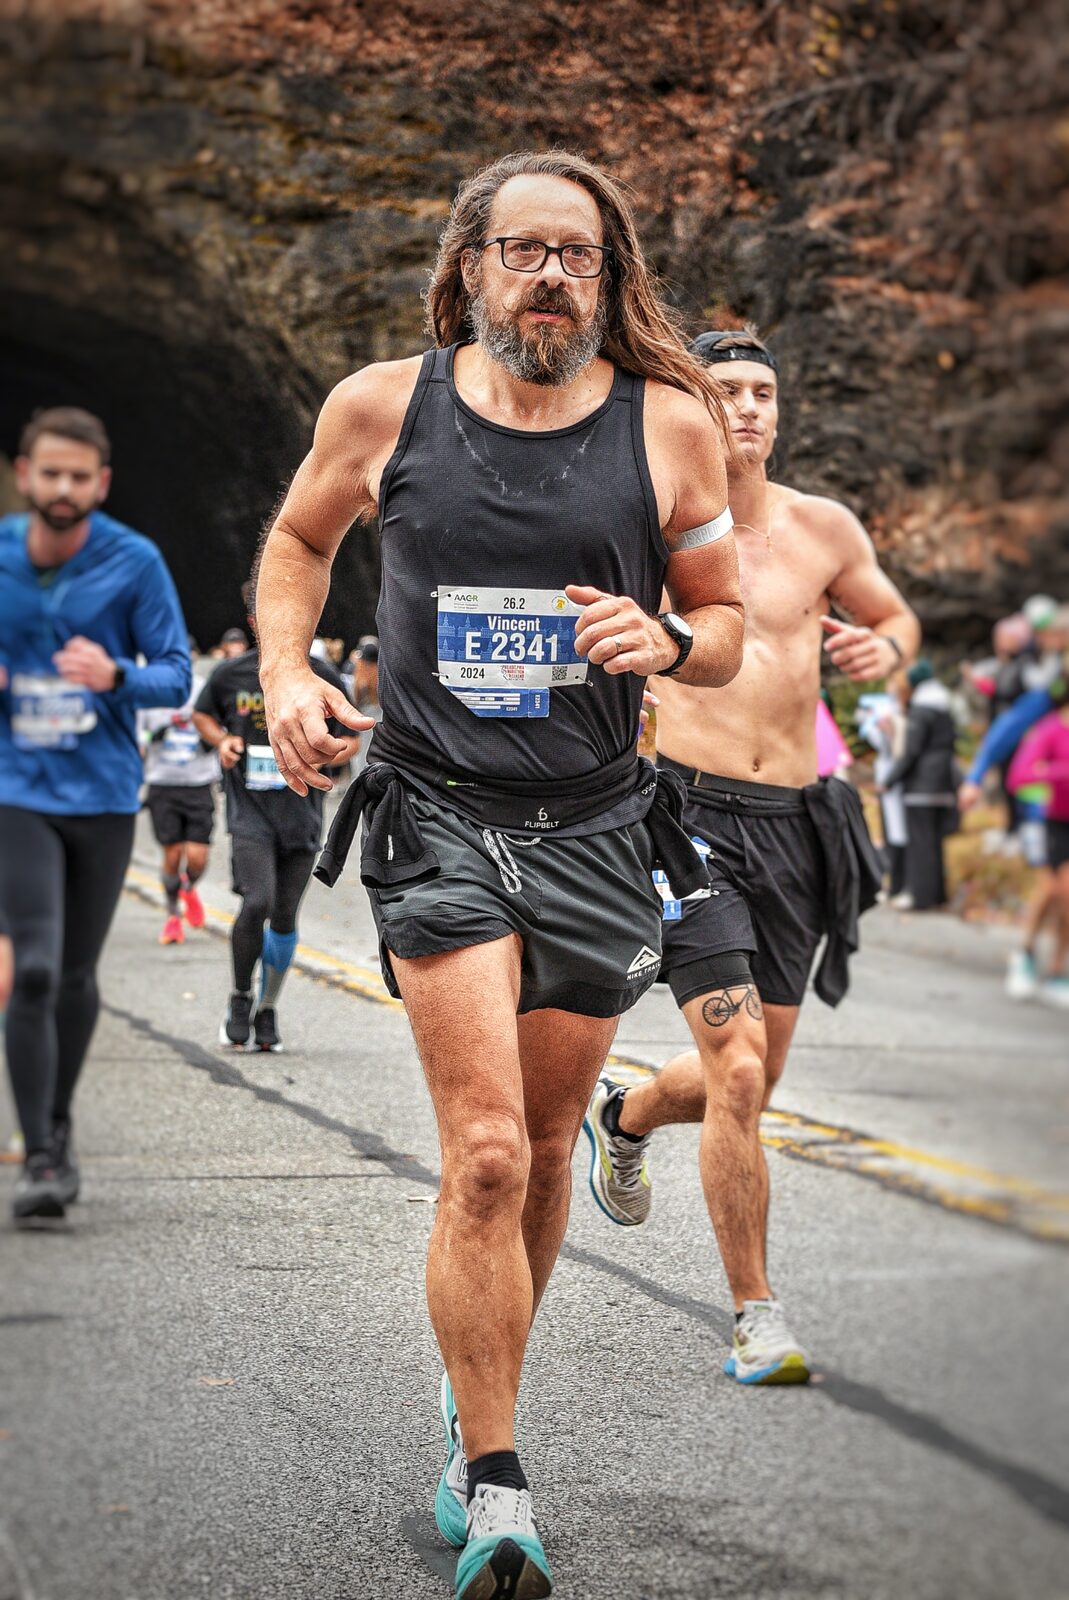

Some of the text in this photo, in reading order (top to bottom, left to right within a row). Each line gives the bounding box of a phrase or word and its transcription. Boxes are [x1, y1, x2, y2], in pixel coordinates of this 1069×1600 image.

[503, 597, 525, 610] 26.2
[487, 615, 541, 632] Vincent
[465, 631, 558, 662] E 2341
[460, 667, 485, 679] 2024
[524, 820, 560, 829] FLIPBELT
[626, 961, 661, 981] NIKE TRAIL
